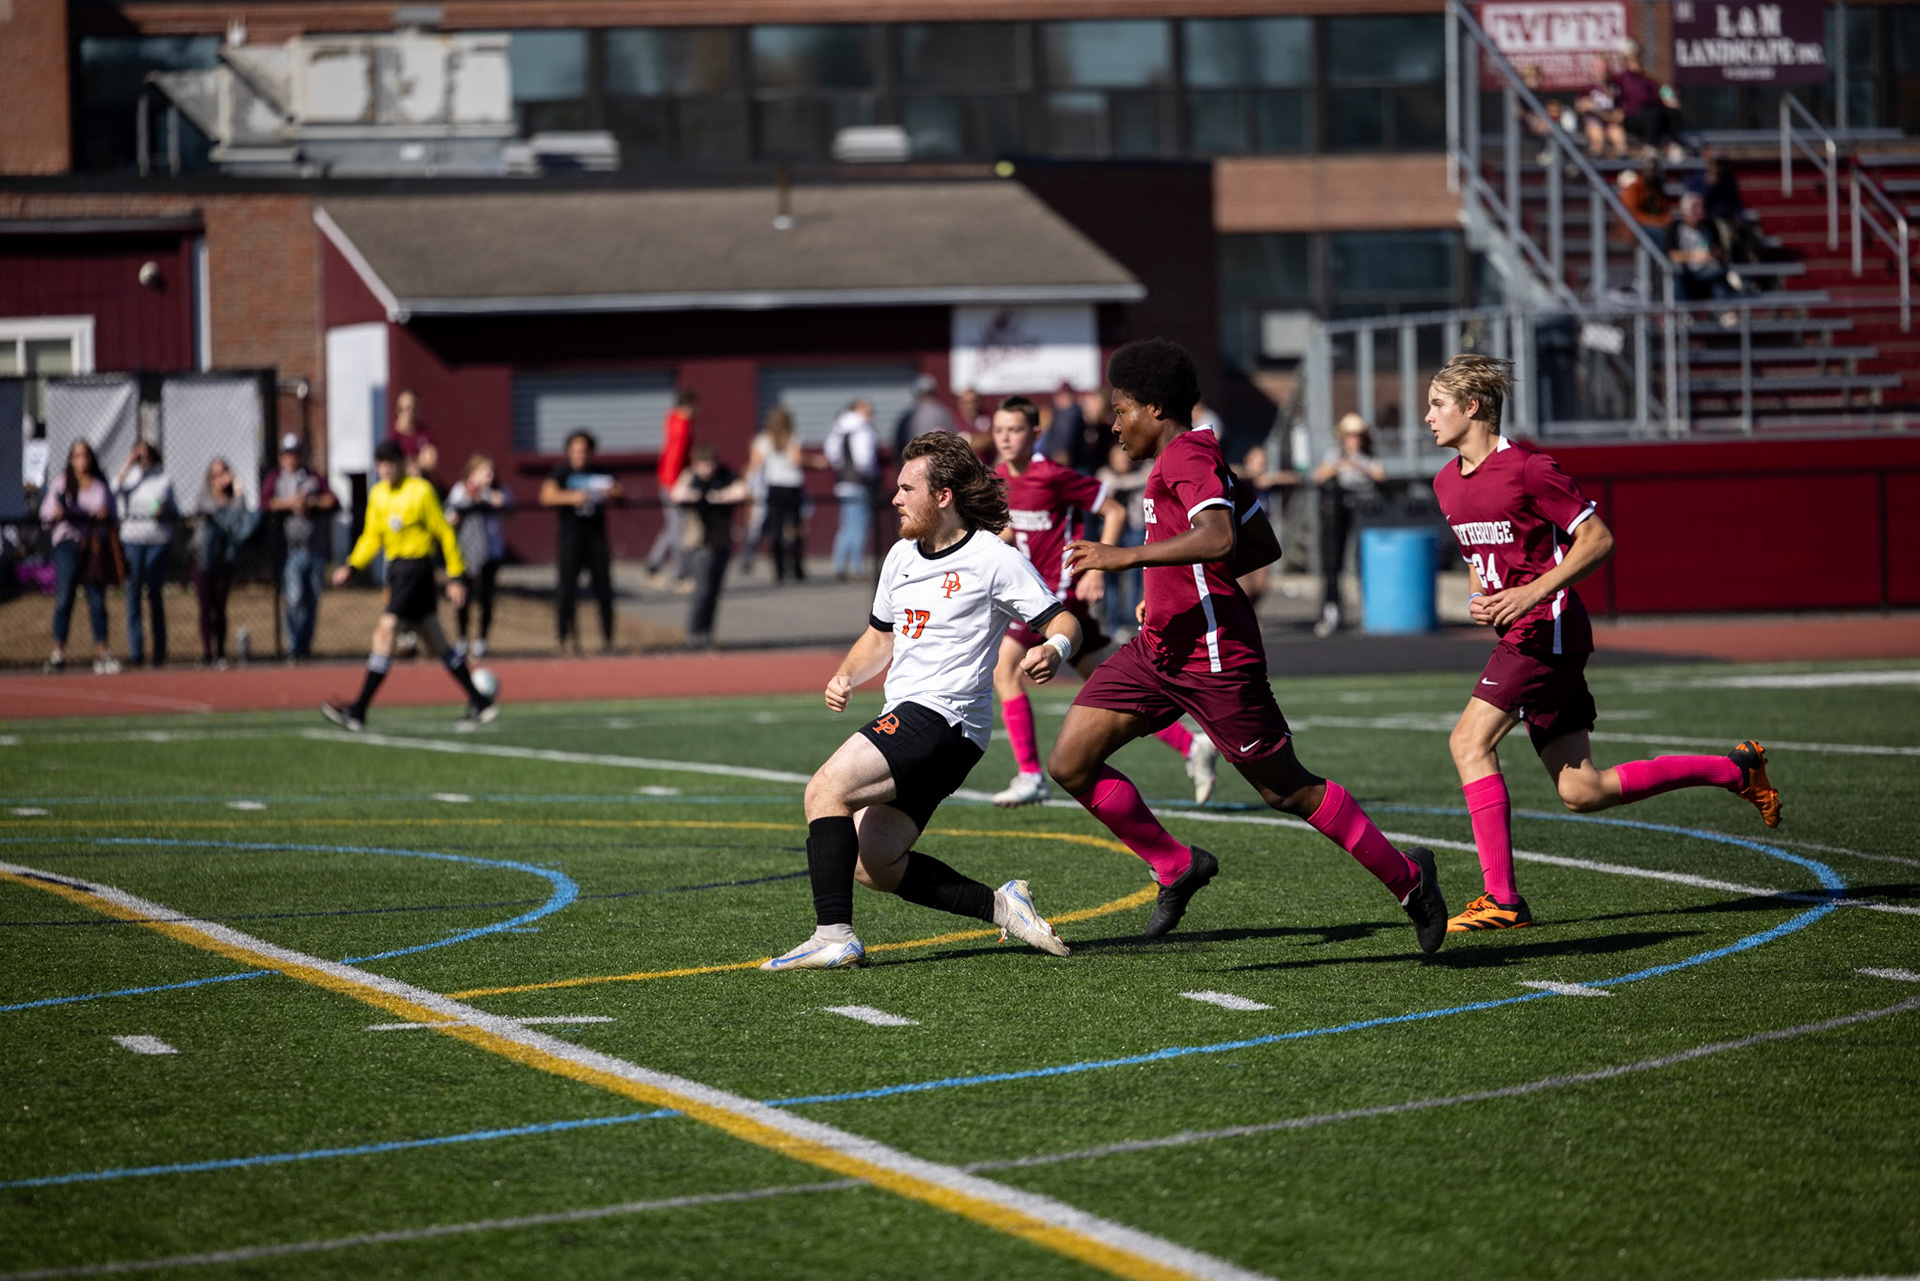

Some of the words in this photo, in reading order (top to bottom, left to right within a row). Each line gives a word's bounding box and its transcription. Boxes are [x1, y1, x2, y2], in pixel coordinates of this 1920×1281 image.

[1676, 38, 1794, 66] LANDSCAPE
[1471, 554, 1502, 589] 24
[902, 609, 930, 639] 17
